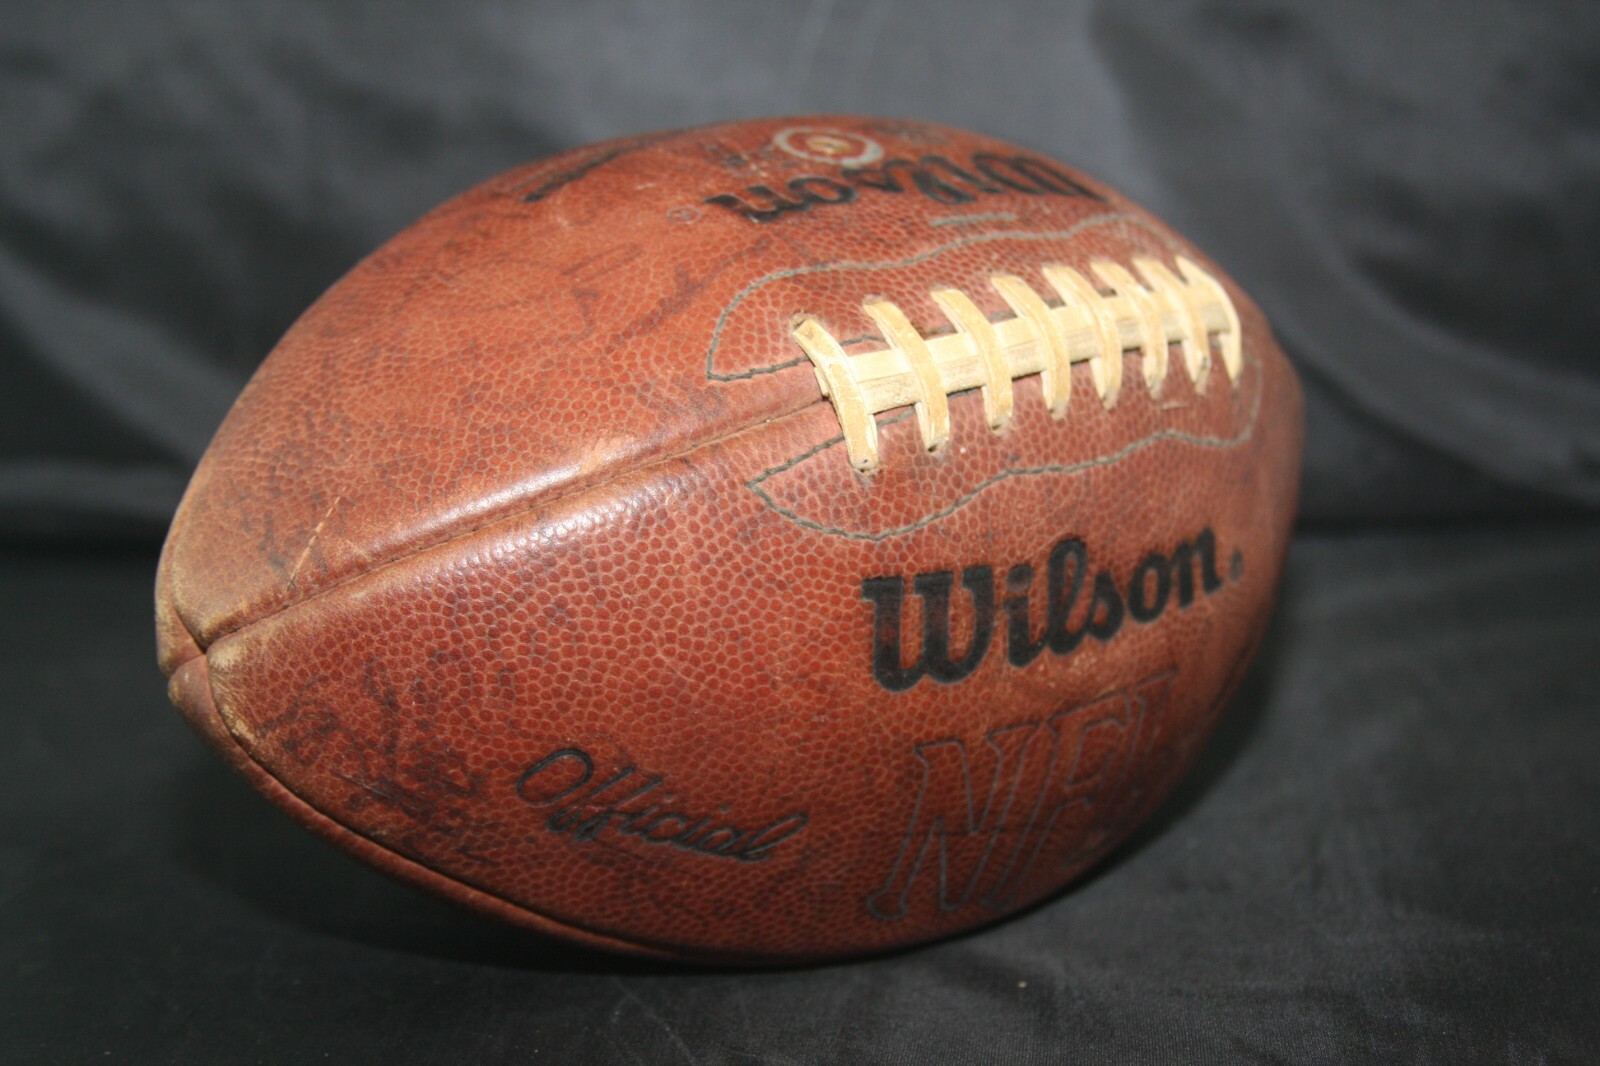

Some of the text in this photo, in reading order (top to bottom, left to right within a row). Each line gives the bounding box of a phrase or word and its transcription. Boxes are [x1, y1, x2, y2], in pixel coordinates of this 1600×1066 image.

[703, 153, 1106, 223] Wilson
[862, 527, 1223, 692] Wilson
[516, 747, 809, 863] Official
